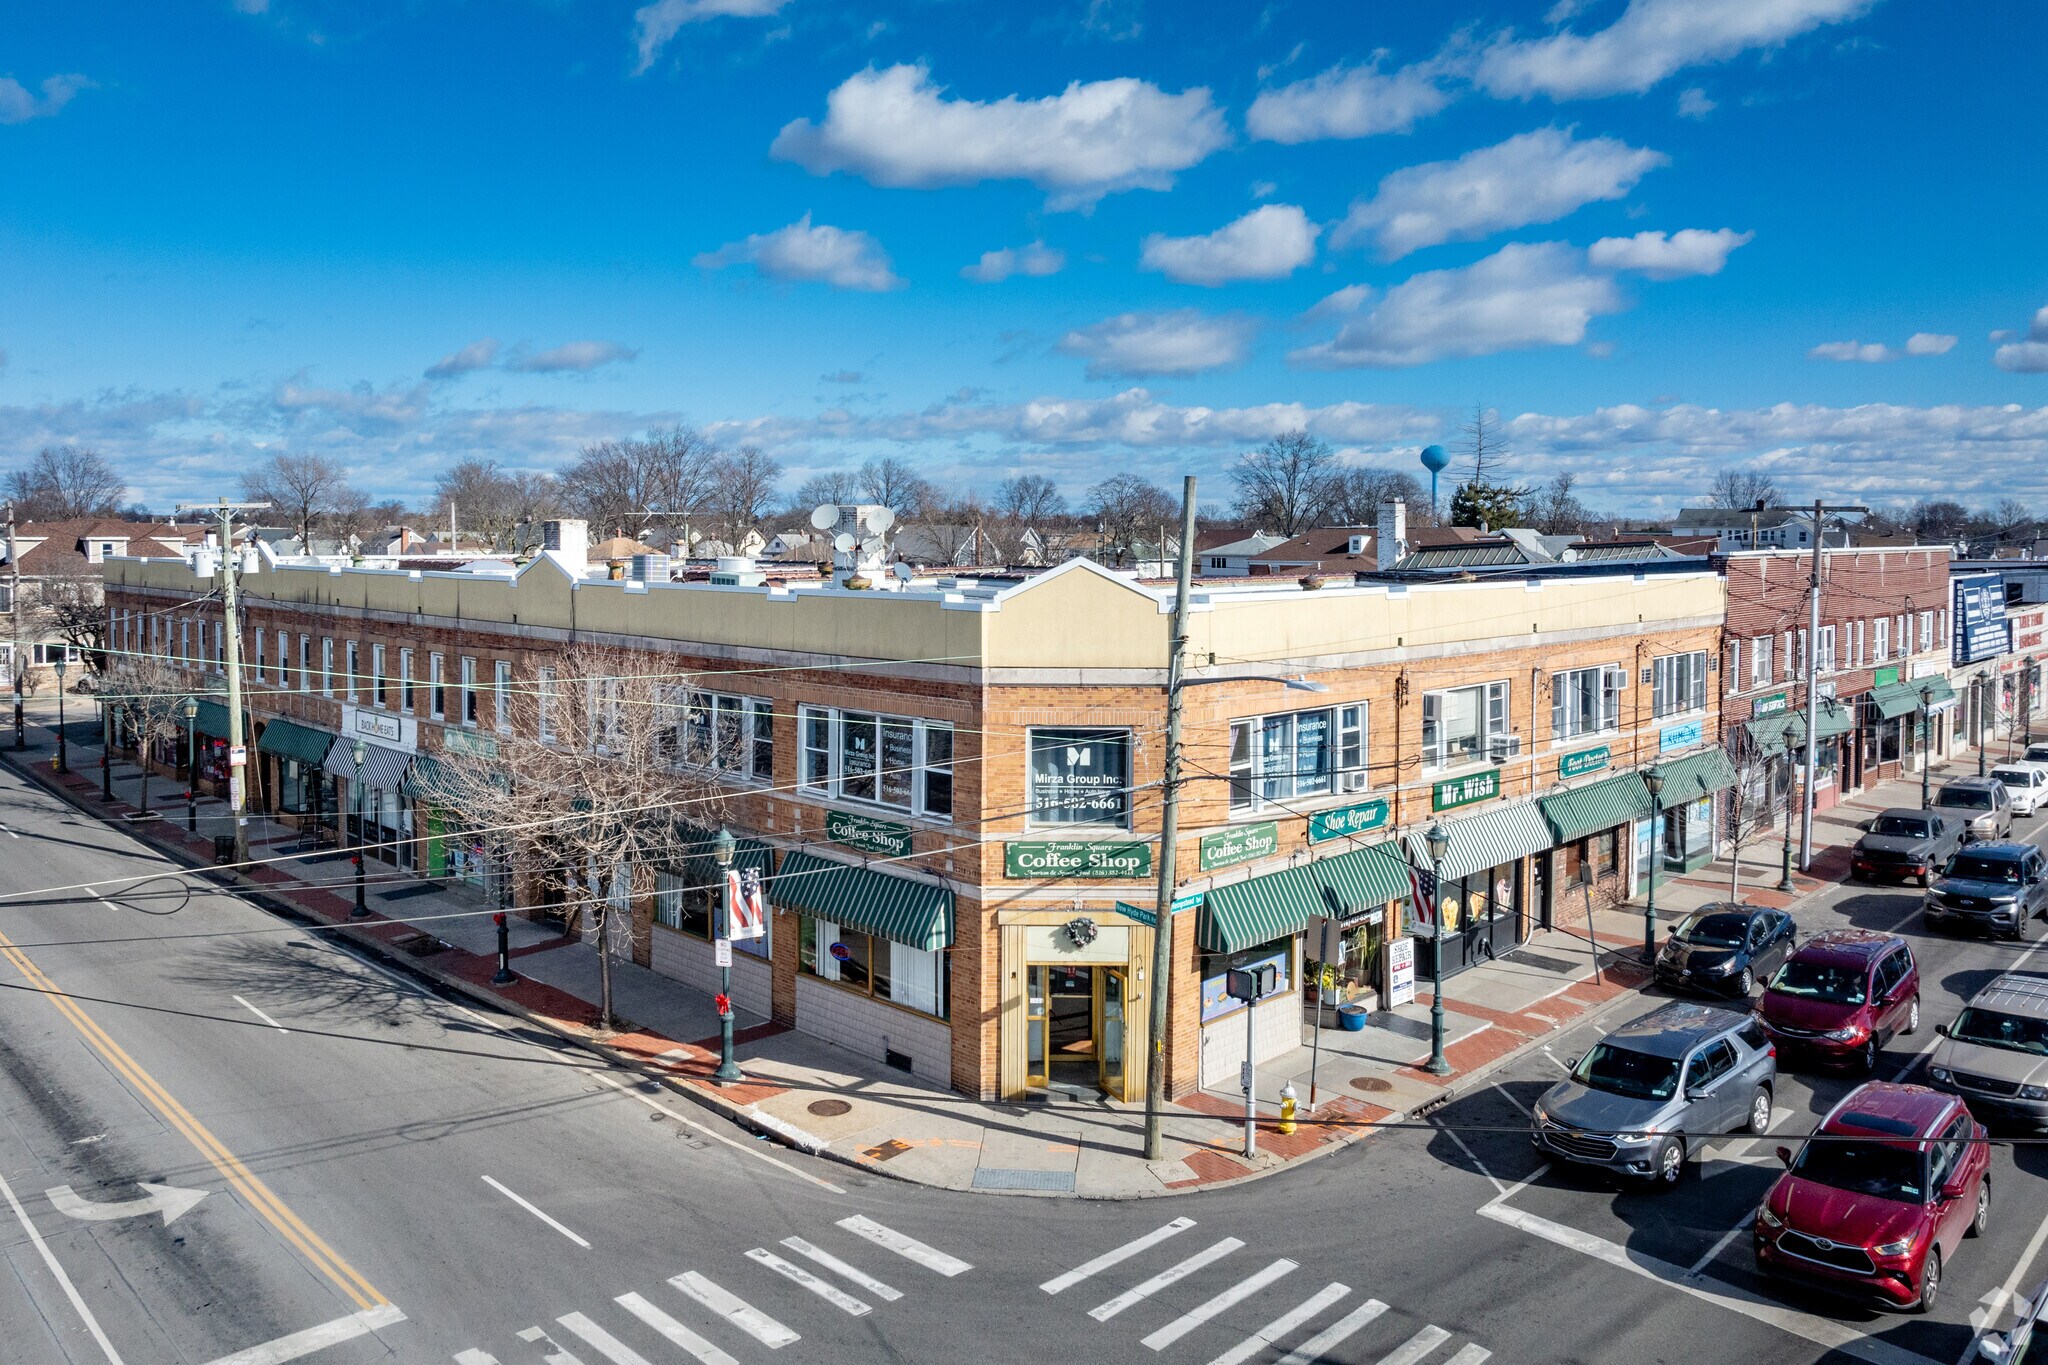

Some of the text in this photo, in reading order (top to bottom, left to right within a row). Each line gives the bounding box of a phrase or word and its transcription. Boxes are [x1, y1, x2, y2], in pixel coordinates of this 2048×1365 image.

[361, 719, 371, 731] BACK
[384, 724, 394, 737] EATS
[882, 728, 913, 741] Insuranc
[1035, 774, 1122, 786] Mirza Group Inc.
[1322, 807, 1378, 834] Shoe Repair
[832, 821, 869, 841] Coffee
[872, 831, 904, 852] Shop
[1046, 842, 1113, 853] Franklin Square
[1207, 841, 1243, 860] Coffee
[1245, 836, 1273, 851] Shop
[1018, 852, 1140, 871] Coffee Shop
[1116, 902, 1126, 912] New
[1127, 907, 1139, 917] Hyde
[1140, 912, 1150, 921] Park
[1393, 941, 1409, 955] SHOE
[1392, 950, 1412, 965] REPAIR
